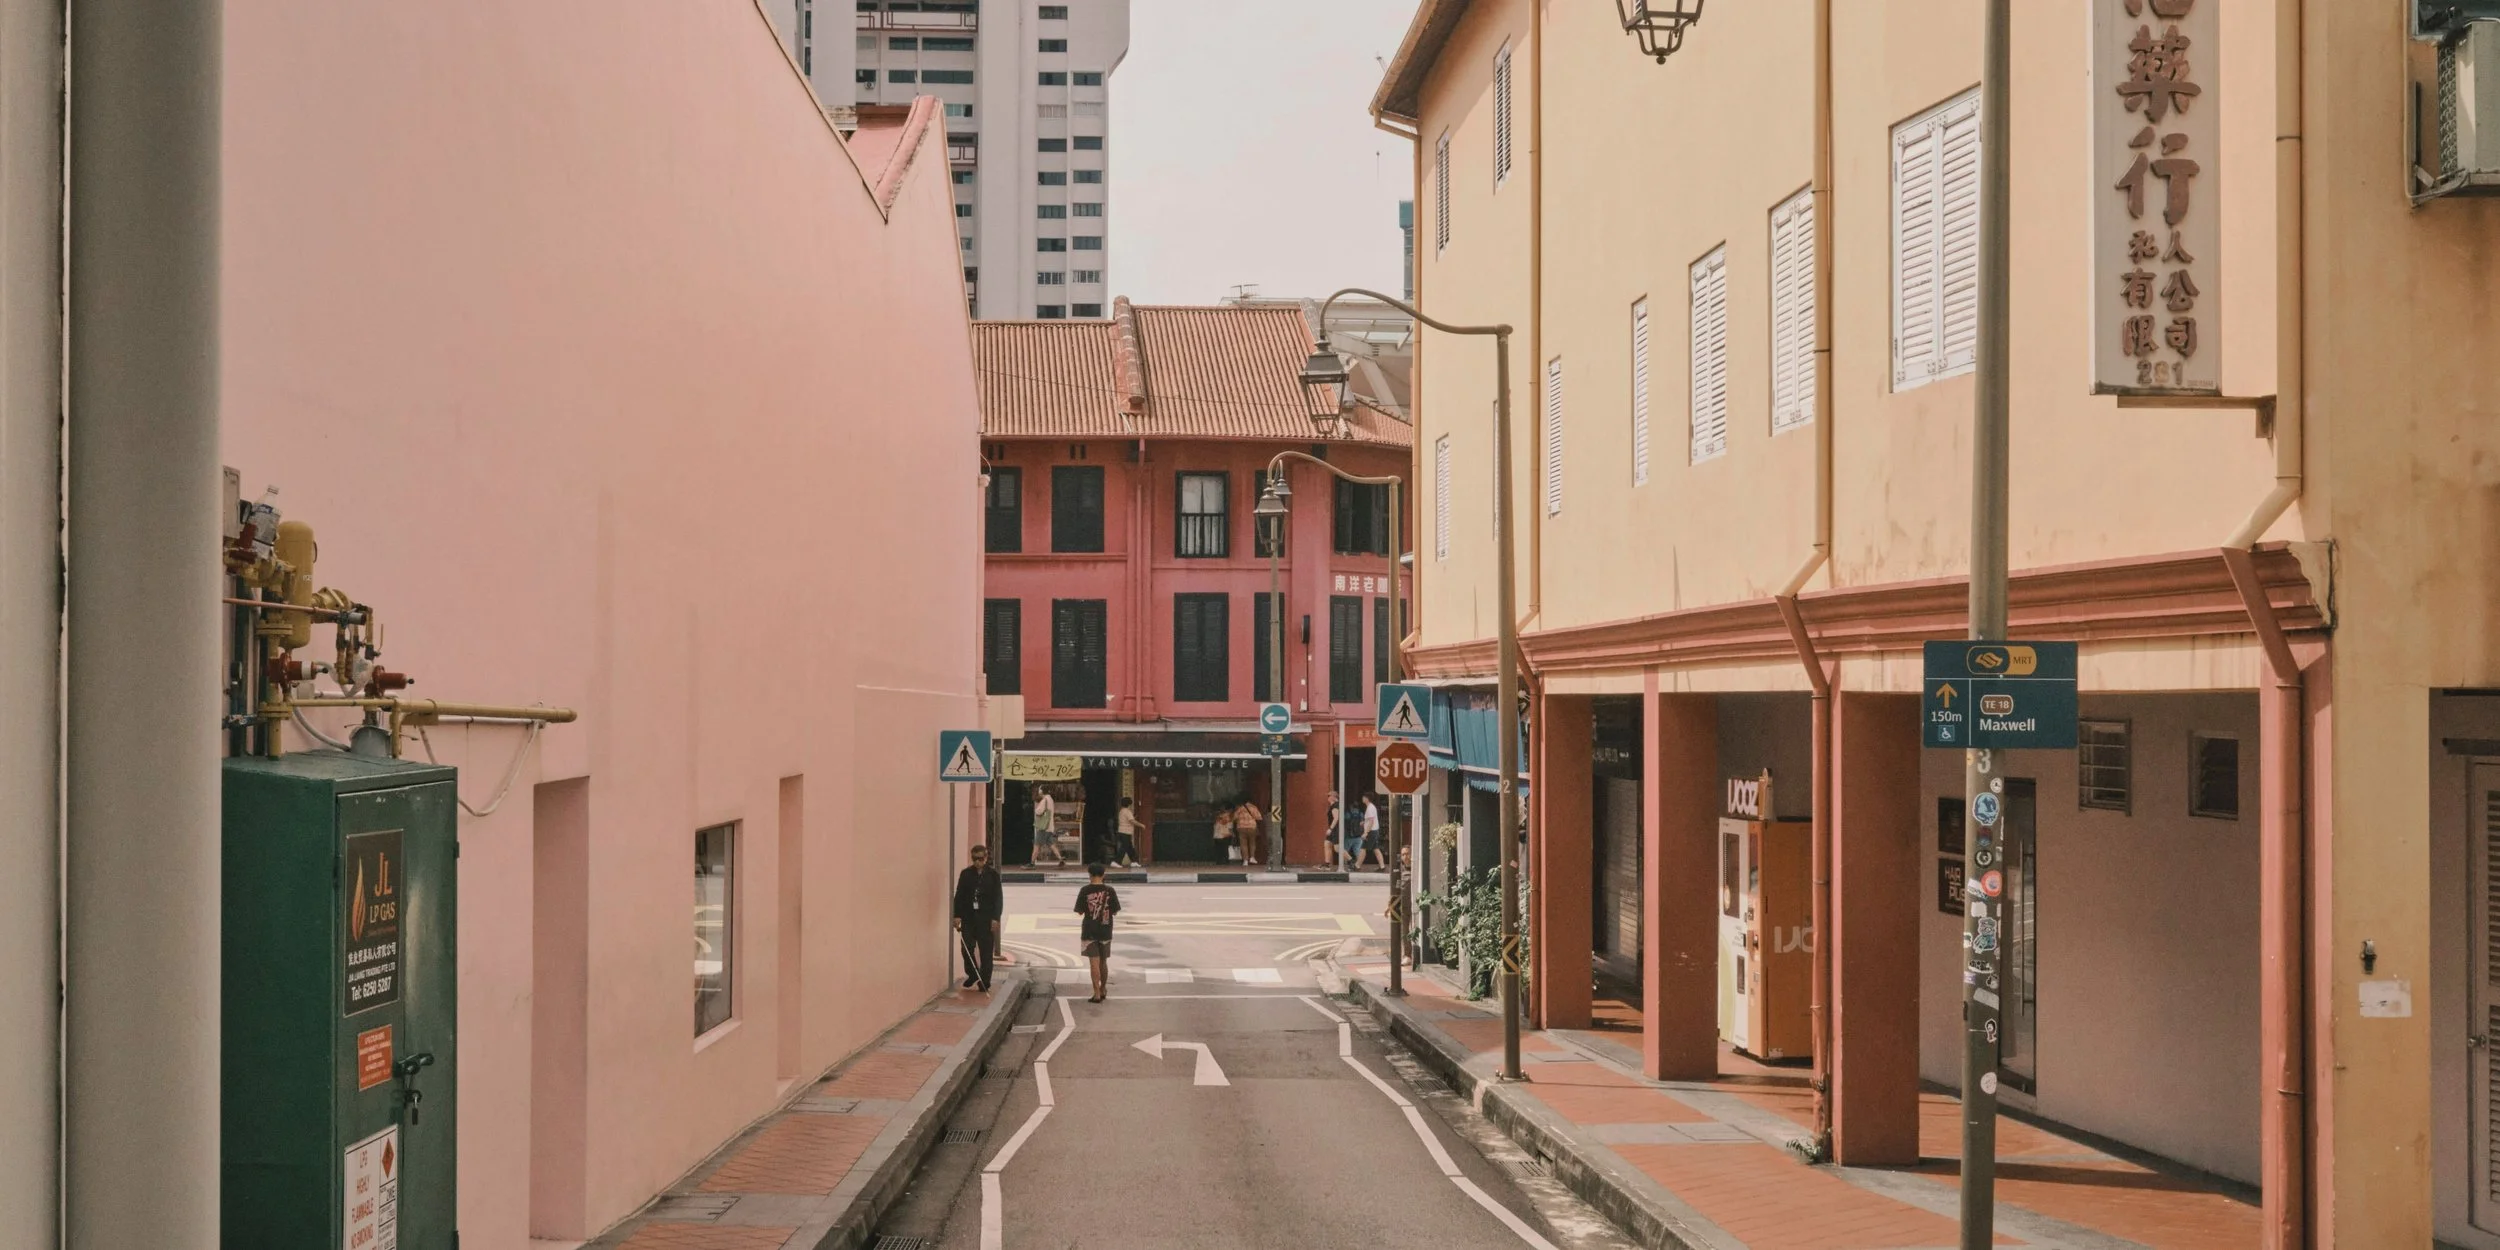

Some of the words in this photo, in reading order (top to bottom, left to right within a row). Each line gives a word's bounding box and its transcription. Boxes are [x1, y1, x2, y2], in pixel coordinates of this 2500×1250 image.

[2114, 0, 2202, 227] 藥行
[2012, 656, 2033, 665] MRT
[1984, 700, 1996, 709] TE
[1998, 700, 2010, 709] 18
[1931, 711, 1962, 722] 150m
[1979, 718, 2035, 732] Maxwell
[1088, 758, 1130, 767] YANG
[1142, 759, 1173, 768] OLD
[1185, 759, 1249, 768] COFFEE
[1379, 758, 1426, 779] STOP
[1977, 748, 1991, 774] 3
[1503, 779, 1511, 794] 2
[374, 852, 393, 897] JL
[369, 904, 379, 923] LP
[380, 902, 396, 921] GAS
